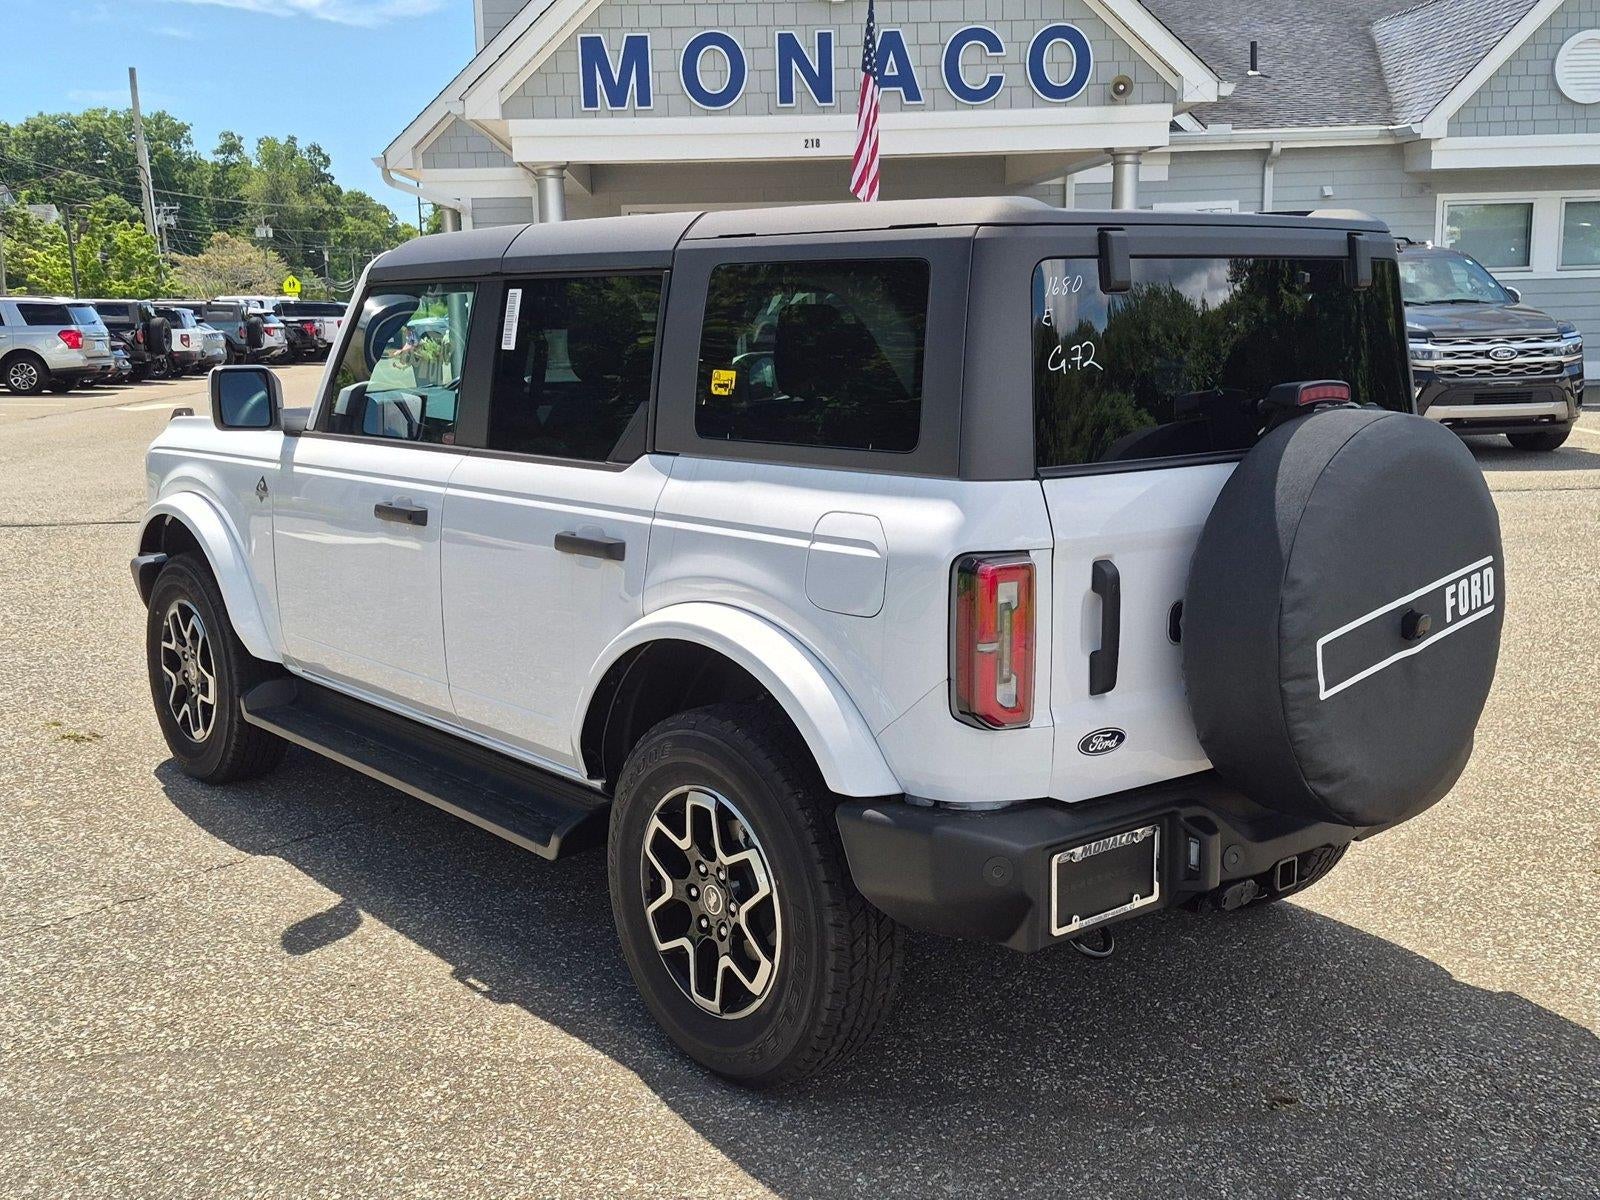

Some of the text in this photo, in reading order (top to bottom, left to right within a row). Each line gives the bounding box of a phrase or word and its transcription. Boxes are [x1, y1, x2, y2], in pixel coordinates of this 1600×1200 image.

[577, 23, 1093, 111] MONACO
[804, 138, 820, 148] 218
[1045, 275, 1082, 297] 1680
[1446, 566, 1494, 623] FORD
[1088, 732, 1119, 752] Ford
[1080, 831, 1137, 858] MONACO
